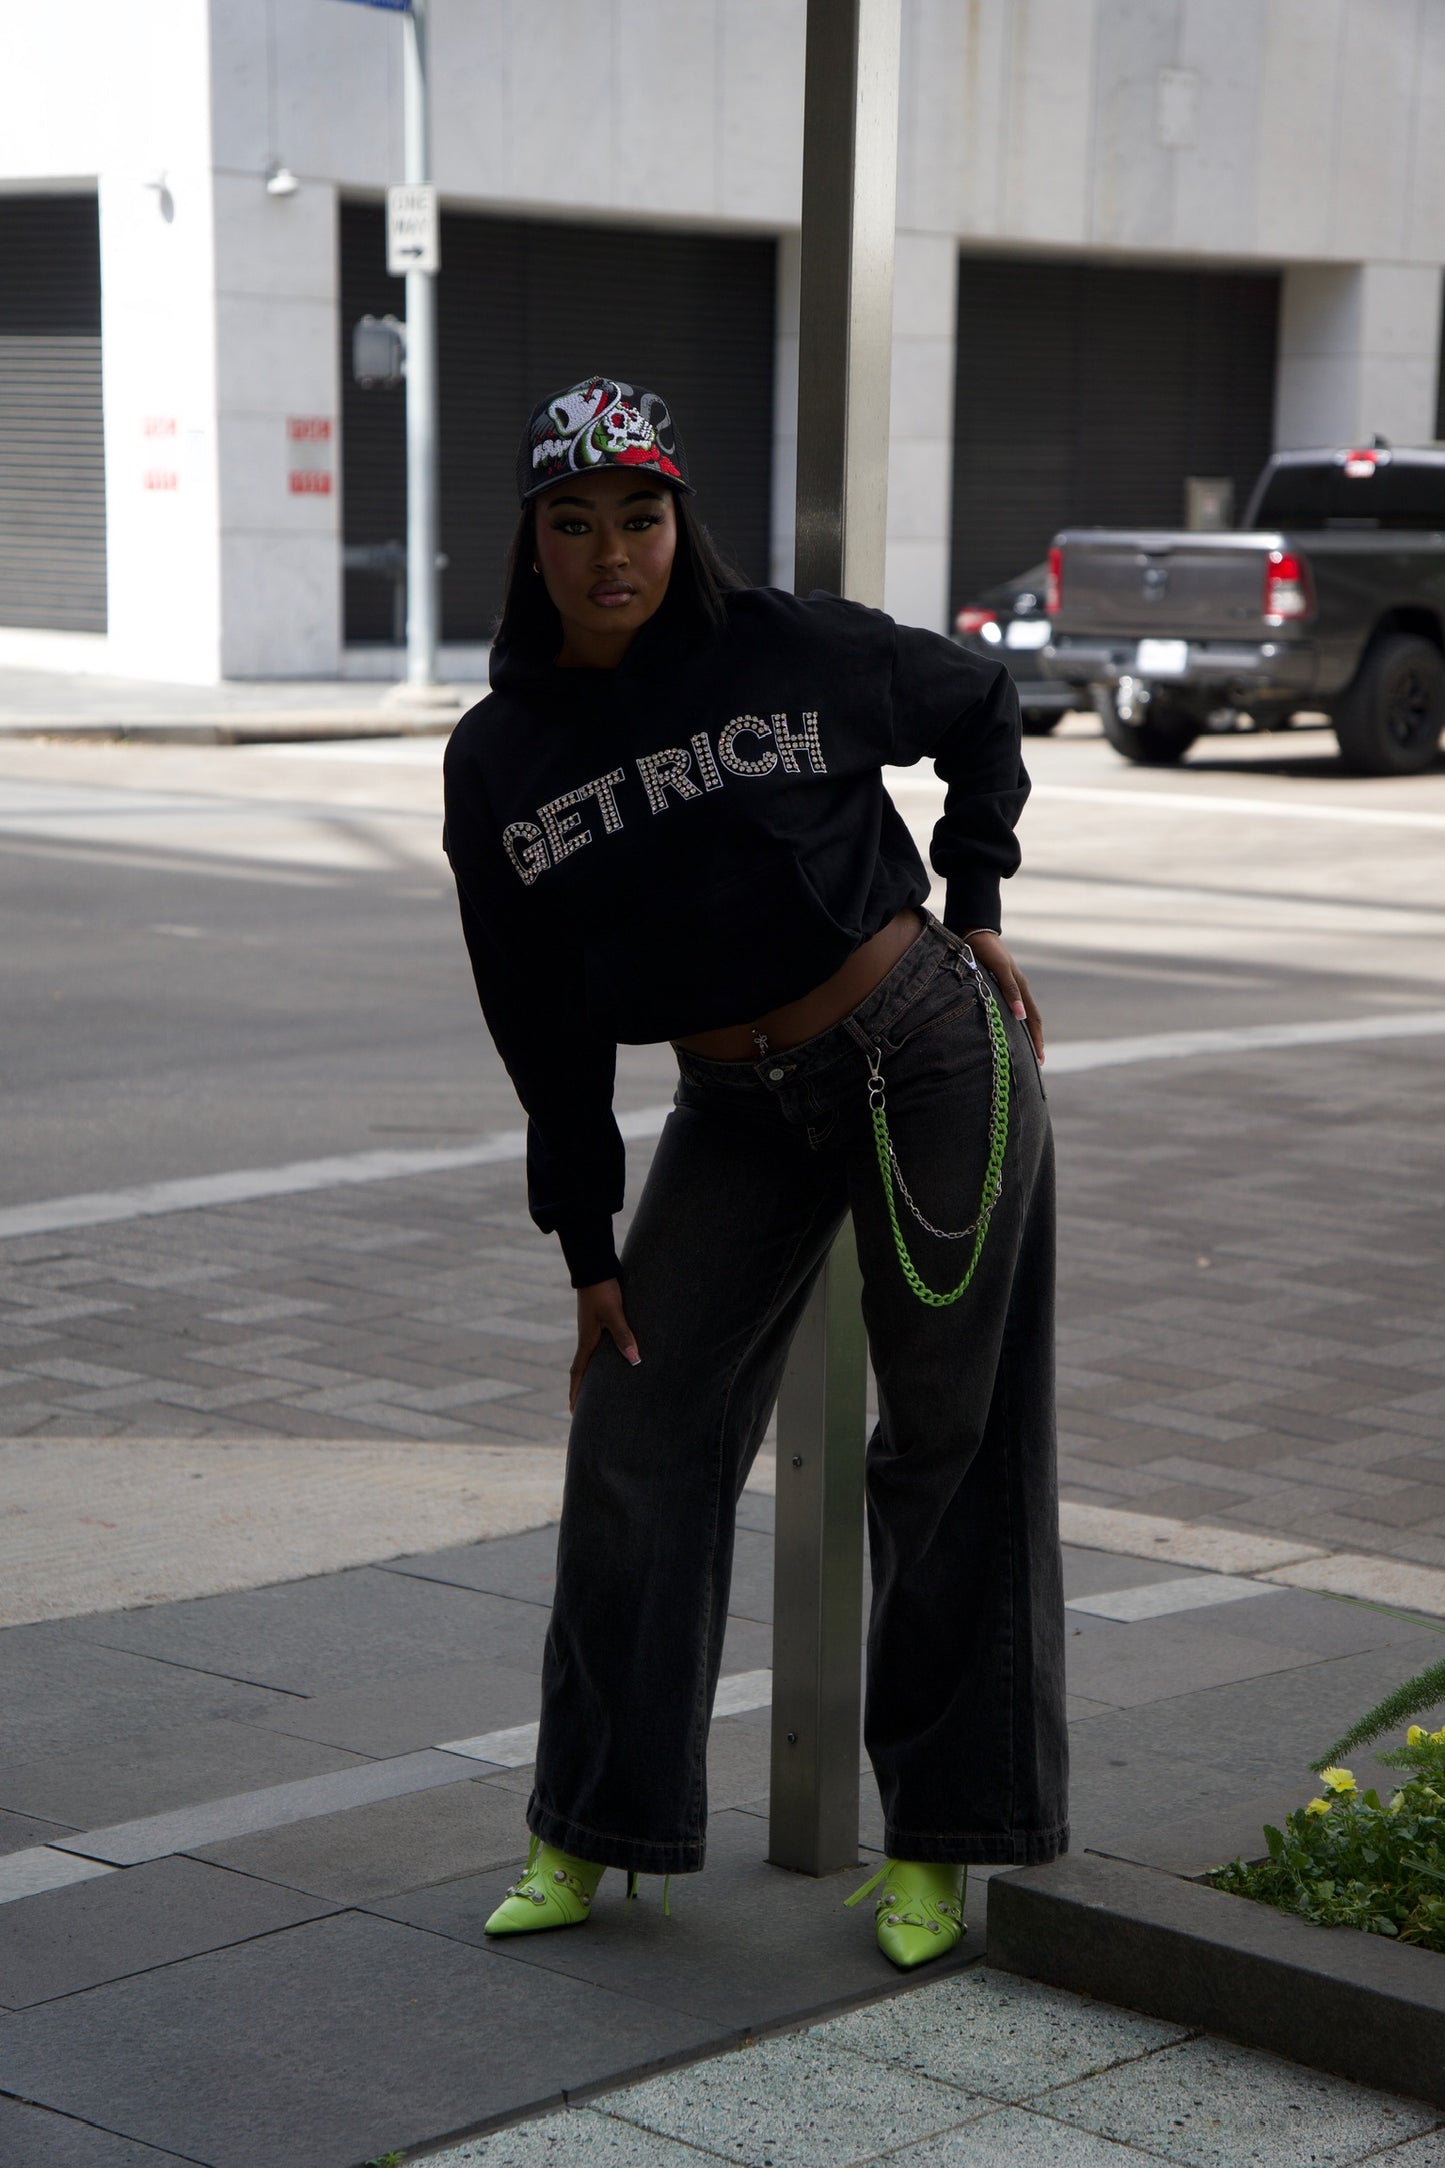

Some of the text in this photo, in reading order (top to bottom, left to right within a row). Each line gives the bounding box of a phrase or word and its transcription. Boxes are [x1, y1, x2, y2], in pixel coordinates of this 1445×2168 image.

[391, 193, 428, 210] ONE
[391, 217, 428, 235] WAY
[502, 711, 828, 886] GET RICH
